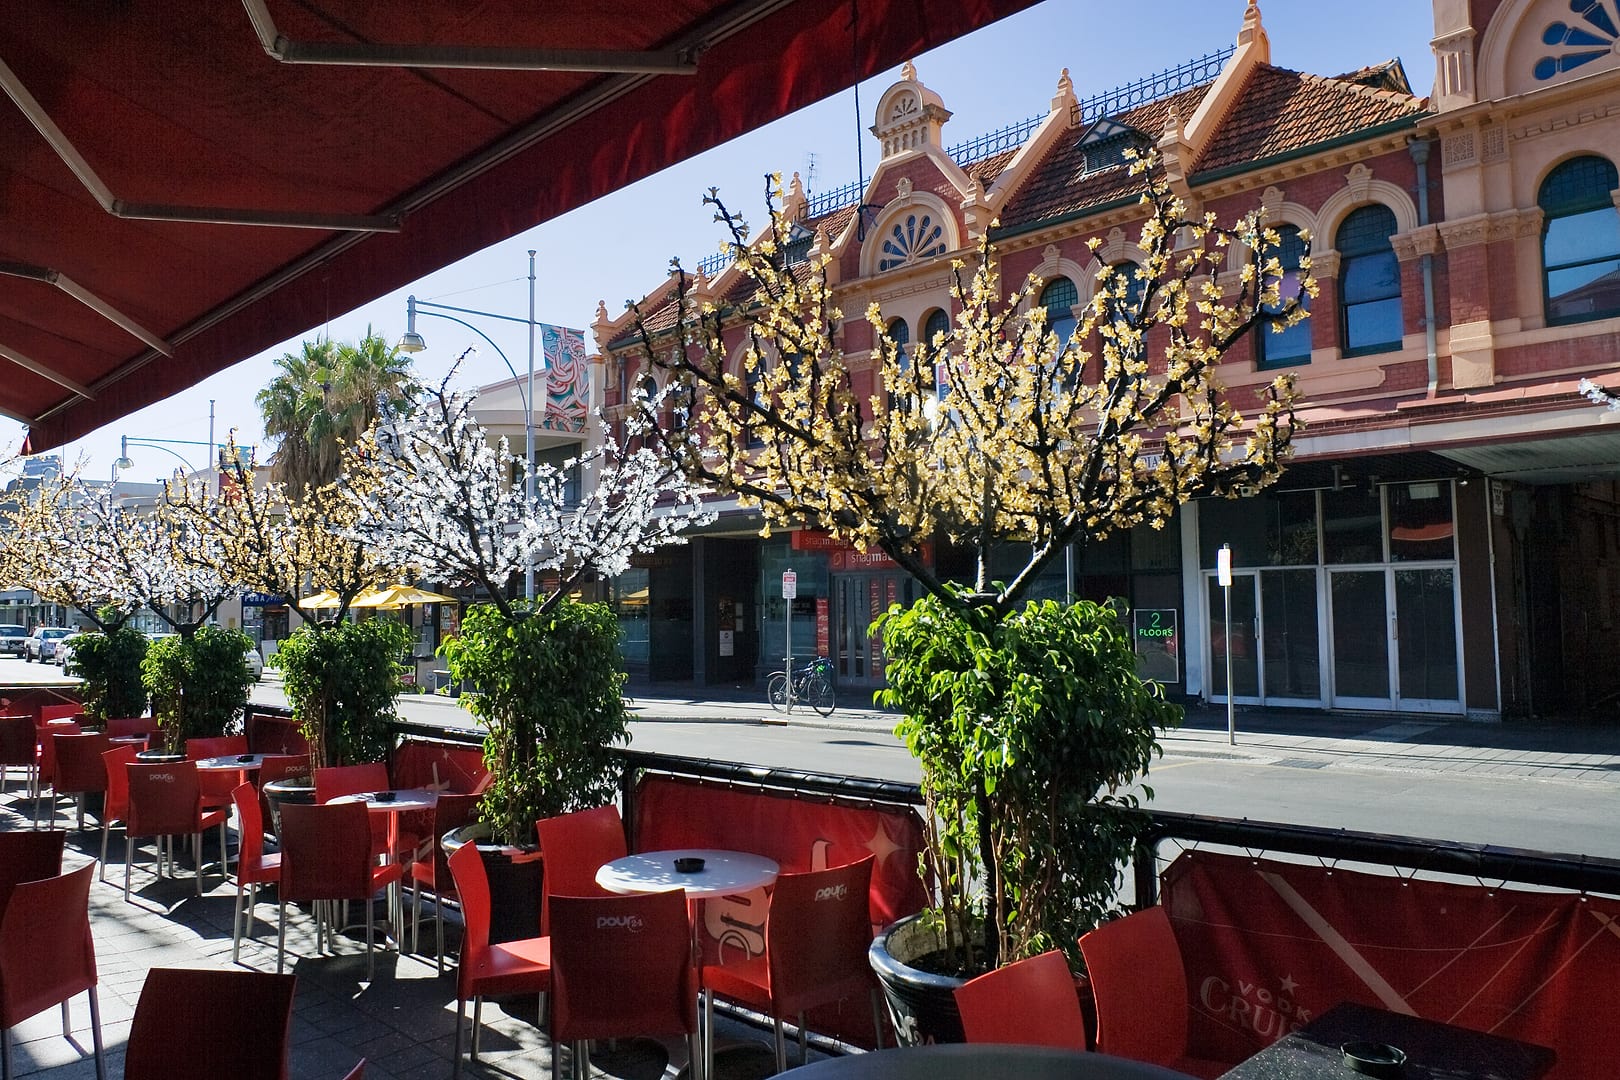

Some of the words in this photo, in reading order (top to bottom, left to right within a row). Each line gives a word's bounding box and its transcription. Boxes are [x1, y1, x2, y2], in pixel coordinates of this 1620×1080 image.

[1151, 612, 1161, 628] 2
[1139, 628, 1173, 637] FLOORS
[814, 883, 845, 902] pour
[596, 915, 635, 929] pour
[1238, 979, 1312, 1023] VODK
